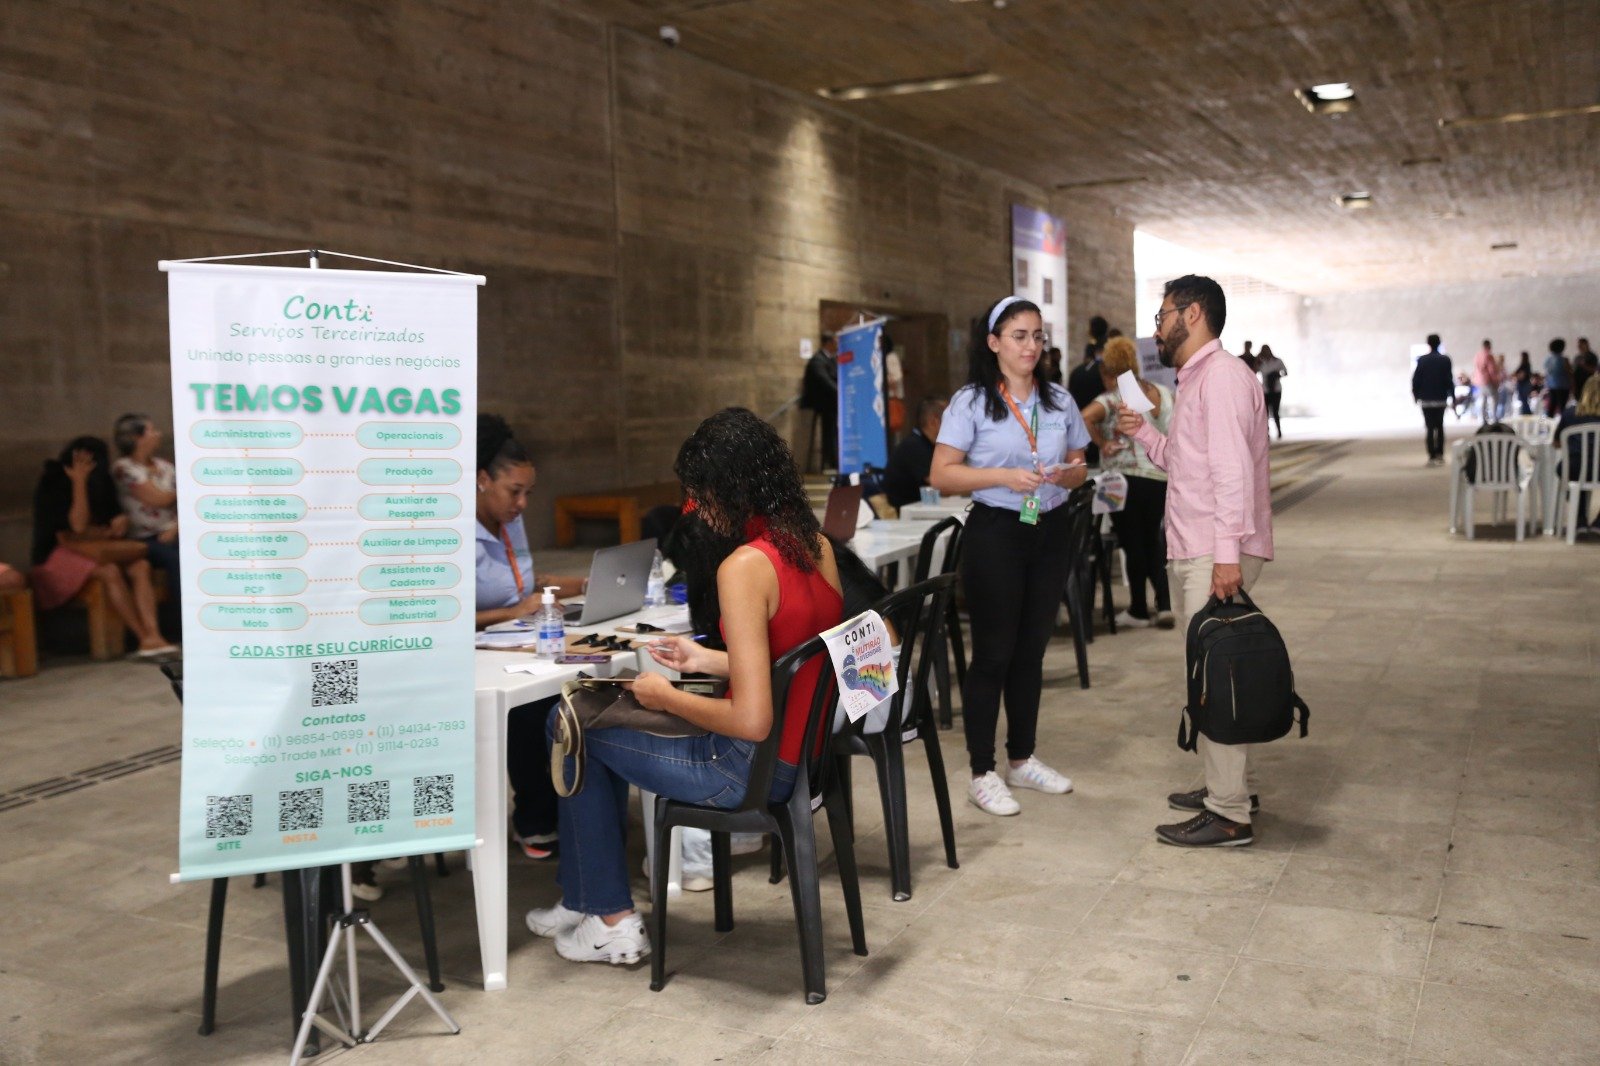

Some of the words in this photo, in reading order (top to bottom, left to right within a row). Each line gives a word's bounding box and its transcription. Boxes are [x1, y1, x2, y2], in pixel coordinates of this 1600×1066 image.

[283, 295, 373, 322] Conti
[230, 322, 304, 342] Serviços
[312, 326, 425, 343] Terceirizados
[187, 349, 243, 362] Unindo
[248, 351, 312, 364] pessoas
[316, 355, 326, 363] a
[330, 355, 391, 368] grandes
[396, 355, 461, 370] negócios
[189, 383, 323, 413] TEMOS
[332, 385, 462, 415] VAGAS
[203, 430, 292, 439] Administrativos
[376, 430, 444, 441] Operacionais
[202, 467, 244, 476] Auxiliar
[385, 467, 433, 478] Produção
[214, 497, 270, 506] Assistente
[273, 497, 286, 506] de
[385, 496, 423, 505] Auxiliar
[425, 496, 438, 505] de
[388, 509, 435, 520] Pesagem
[216, 535, 272, 543] Assistente
[275, 535, 288, 543] de
[363, 538, 402, 547] Auxiliar
[403, 538, 416, 546] de
[418, 537, 459, 548] Limpeza
[380, 565, 432, 575] Assistente
[433, 565, 445, 574] de
[226, 571, 282, 581] Assistente
[389, 577, 436, 588] Cadastro
[218, 606, 267, 614] Promotor
[269, 605, 293, 614] com
[389, 610, 436, 620] Industrial
[242, 619, 268, 628] Moto
[845, 622, 875, 645] CONTI
[230, 644, 313, 657] CADASTRE
[317, 642, 344, 655] SEU
[349, 636, 433, 654] CURRÍCULO
[302, 712, 366, 727] Contatos
[192, 737, 245, 749] Seleção
[262, 735, 282, 748] (11)
[285, 729, 364, 745] 96854-0699
[376, 725, 395, 739] (11)
[398, 720, 466, 735] 94134-7893
[224, 753, 277, 767] Seleção
[281, 749, 317, 763] Trade
[319, 746, 342, 759] Mkt
[354, 743, 373, 756] (11)
[295, 765, 373, 783] SIGA-NOS
[414, 817, 454, 828] TIKTOK
[354, 824, 384, 834] FACE
[282, 832, 318, 844] INSTA
[216, 840, 242, 850] SITE
